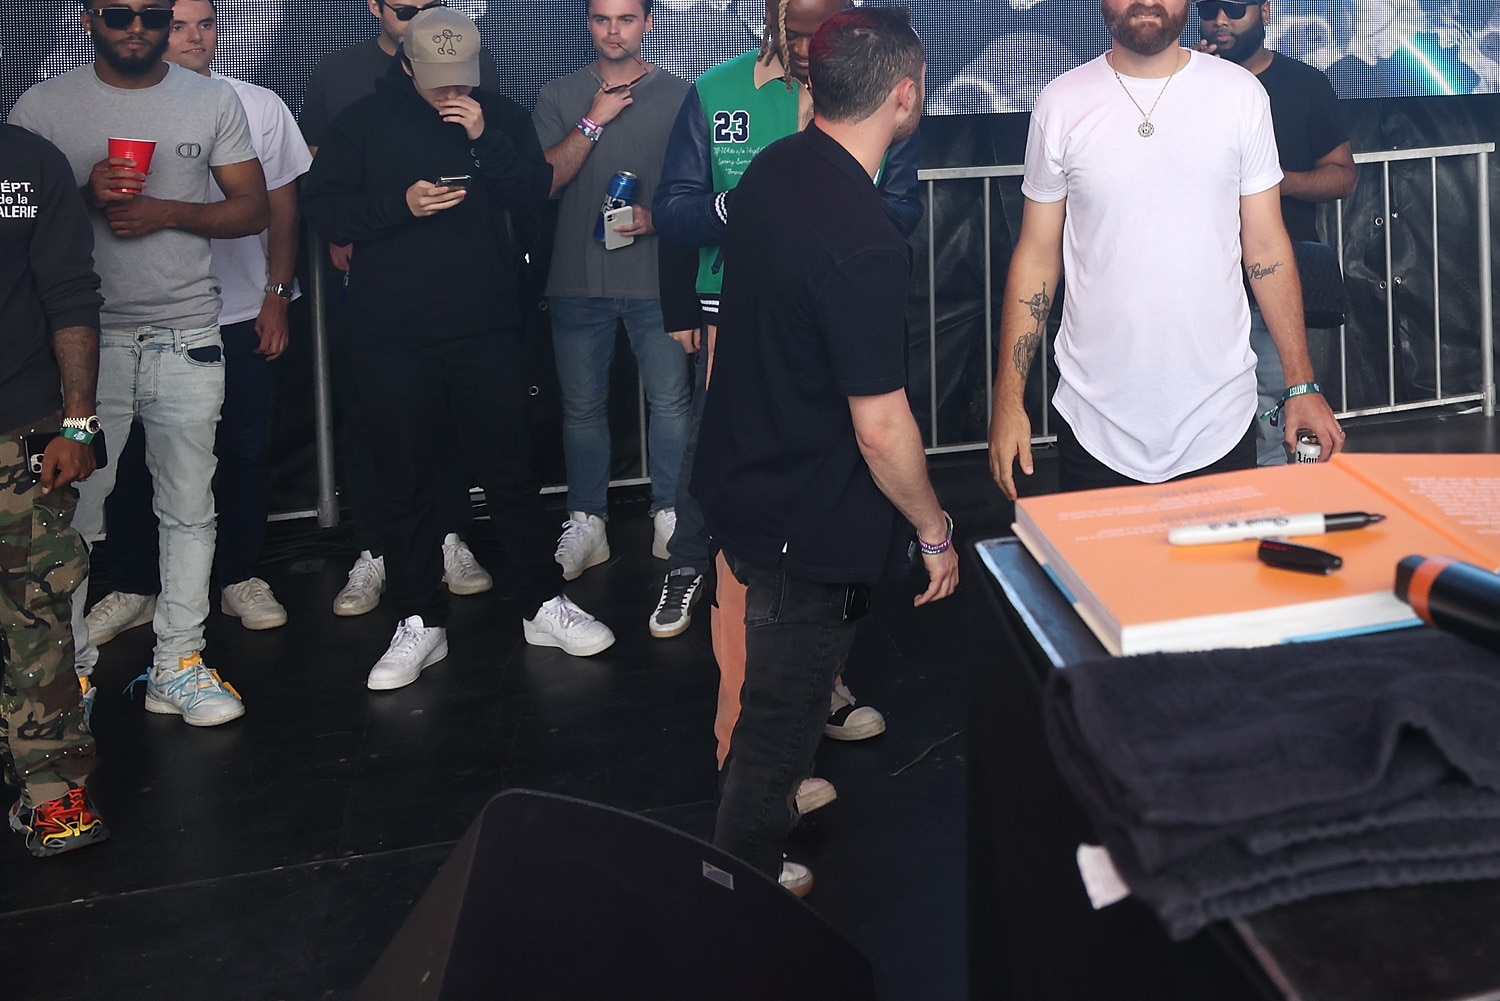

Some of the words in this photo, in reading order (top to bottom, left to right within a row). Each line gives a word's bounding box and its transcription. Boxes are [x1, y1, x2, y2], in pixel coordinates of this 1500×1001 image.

[713, 110, 750, 143] 23
[17, 193, 28, 205] la
[1289, 383, 1307, 397] ARTIST
